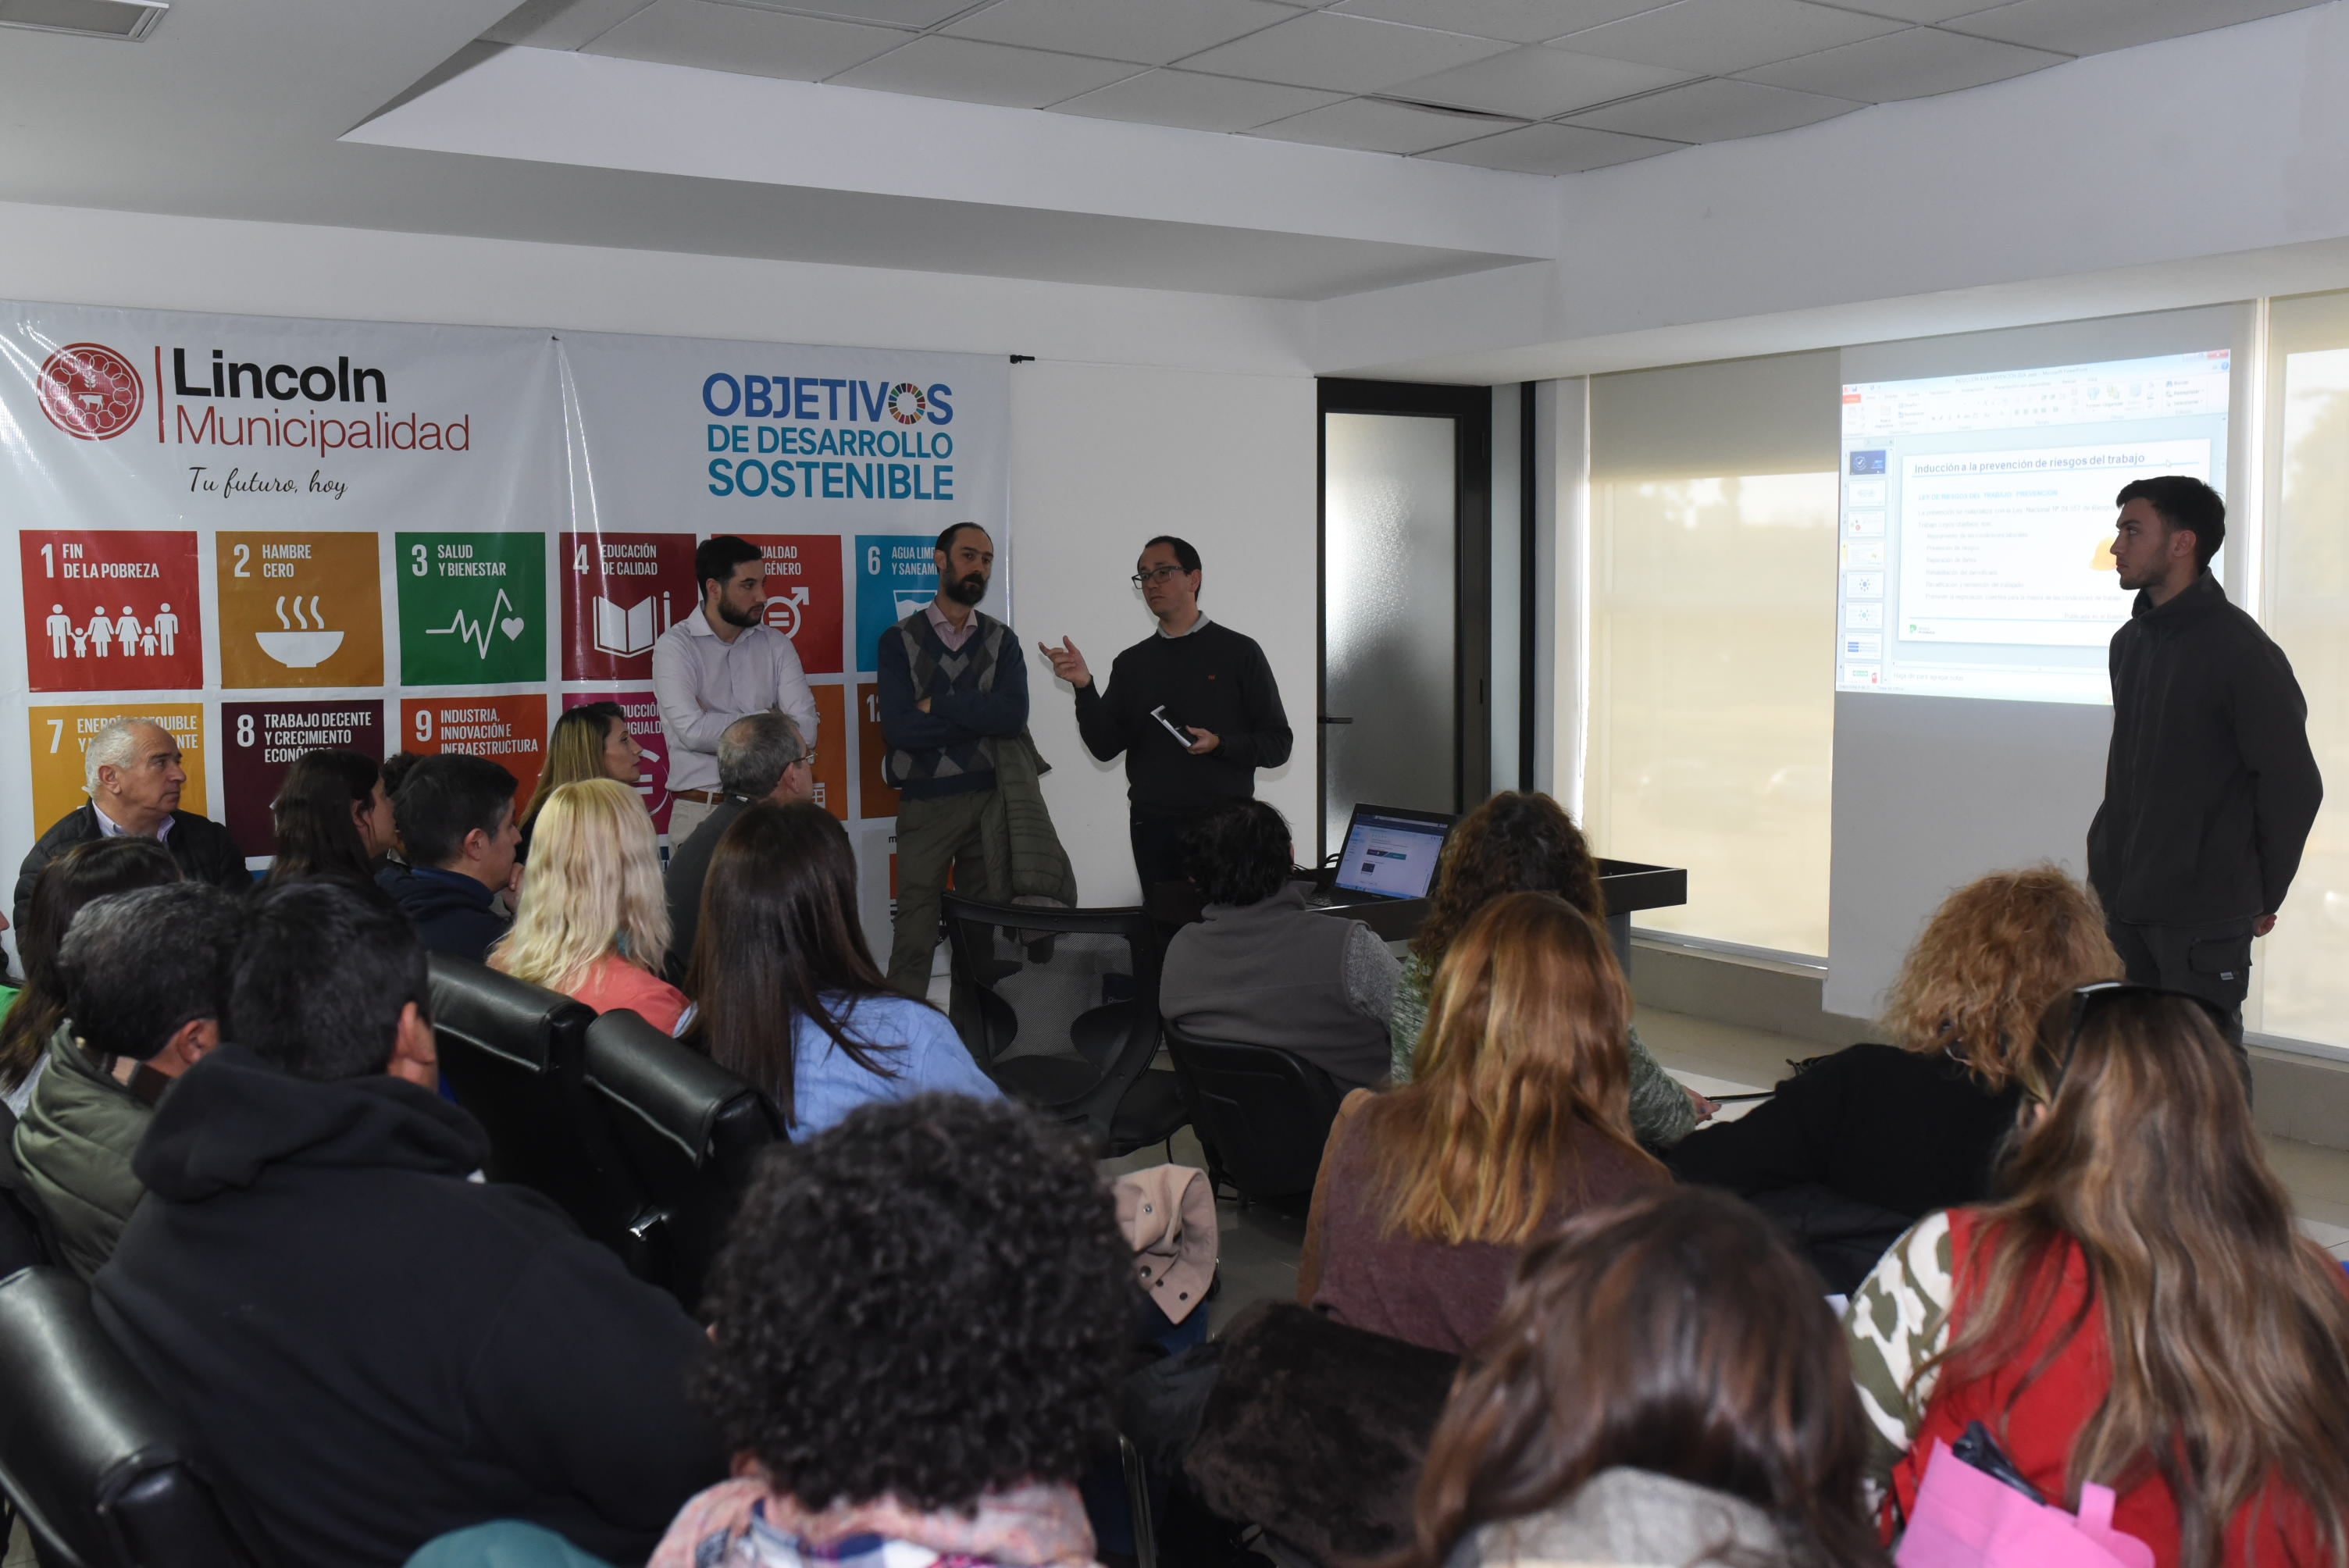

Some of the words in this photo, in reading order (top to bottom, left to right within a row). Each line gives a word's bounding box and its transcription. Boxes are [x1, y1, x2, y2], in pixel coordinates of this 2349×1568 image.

[173, 347, 387, 403] Lincoln
[703, 372, 954, 426] OBJETIVOS
[176, 404, 469, 458] Municipalidad
[708, 424, 750, 453] DE
[757, 426, 954, 459] DESARROLLO
[1915, 462, 1959, 473] Inducción
[1969, 462, 1977, 472] la
[1980, 459, 2033, 474] prevención
[2035, 458, 2048, 469] de
[2049, 458, 2087, 469] riesgos
[2089, 455, 2105, 465] del
[2107, 453, 2145, 465] trabajo
[190, 466, 218, 493] Tu
[224, 468, 299, 500] futuro,
[308, 469, 349, 500] hoy
[708, 458, 954, 501] SOSTENIBLE
[62, 543, 83, 559] FIN
[262, 544, 312, 560] HAMBRE
[437, 544, 473, 559] SALUD
[601, 543, 657, 559] EDUCACIÓN
[760, 545, 797, 559] UALDAD
[892, 547, 914, 559] AGUA
[917, 547, 936, 559] LIMP
[41, 543, 55, 579] 1
[233, 543, 251, 578] 2
[412, 544, 428, 576] 3
[573, 544, 590, 576] 4
[602, 561, 615, 576] DE
[616, 561, 658, 576] CALIDAD
[765, 560, 801, 575] GÉNERO
[868, 546, 881, 576] 6
[63, 562, 80, 579] DE
[83, 562, 99, 579] LA
[102, 563, 159, 579] POBREZA
[262, 563, 294, 579] CERO
[438, 562, 446, 576] Y
[447, 561, 507, 577] BIENESTAR
[892, 562, 897, 576] Y
[899, 562, 939, 576] SANEAMI
[440, 708, 501, 724] INDUSTRIA,
[866, 693, 882, 722] 1
[264, 713, 319, 728] TRABAJO
[322, 711, 372, 727] DECENTE
[415, 710, 433, 742] 9
[47, 719, 63, 754] 7
[237, 714, 255, 747] 8
[265, 732, 273, 746] Y
[275, 729, 351, 745] CRECIMIENTO
[440, 723, 504, 740] INNOVACIÓN
[506, 723, 512, 737] E
[77, 737, 86, 753] Y
[440, 739, 538, 756] INFRAESTRUCTURA
[265, 746, 333, 763] ECONÓ
